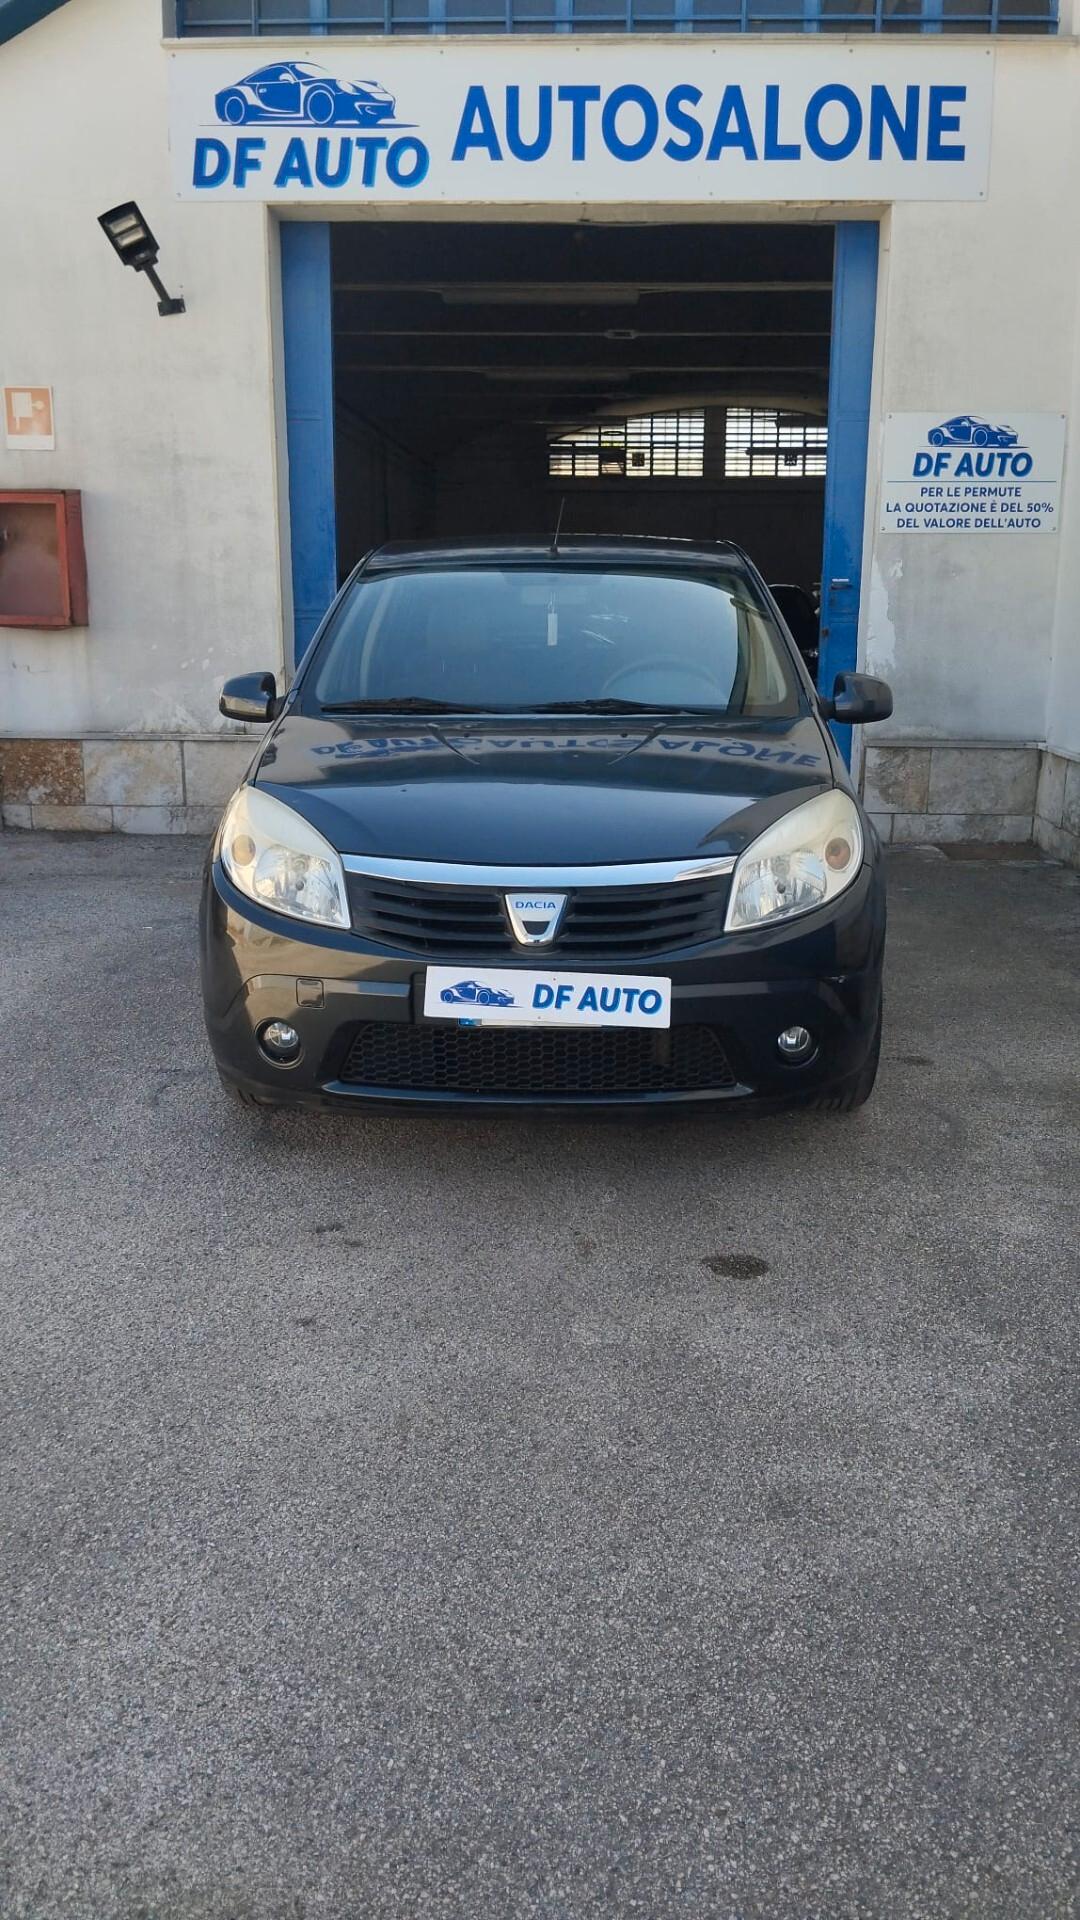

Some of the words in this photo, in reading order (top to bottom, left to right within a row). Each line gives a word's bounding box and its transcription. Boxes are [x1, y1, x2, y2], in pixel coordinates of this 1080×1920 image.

[450, 83, 967, 162] AUTOSALONE
[192, 137, 266, 189] DF
[273, 135, 430, 189] AUTO
[912, 452, 952, 478] DF
[954, 452, 1034, 478] AUTO
[920, 486, 944, 497] PER
[946, 486, 961, 497] LE
[964, 486, 1022, 497] PERMUTE
[886, 502, 901, 513] LA
[905, 502, 987, 514] QUOTAZIONE
[990, 499, 997, 513] È
[1000, 502, 1023, 513] DEL
[1027, 502, 1054, 513] 50%
[896, 518, 919, 528] DEL
[924, 518, 971, 528] VALORE
[974, 517, 1041, 528] DELL'AUTO
[515, 901, 556, 910] DACIA
[532, 983, 574, 1010] DF
[577, 986, 662, 1014] AUTO
